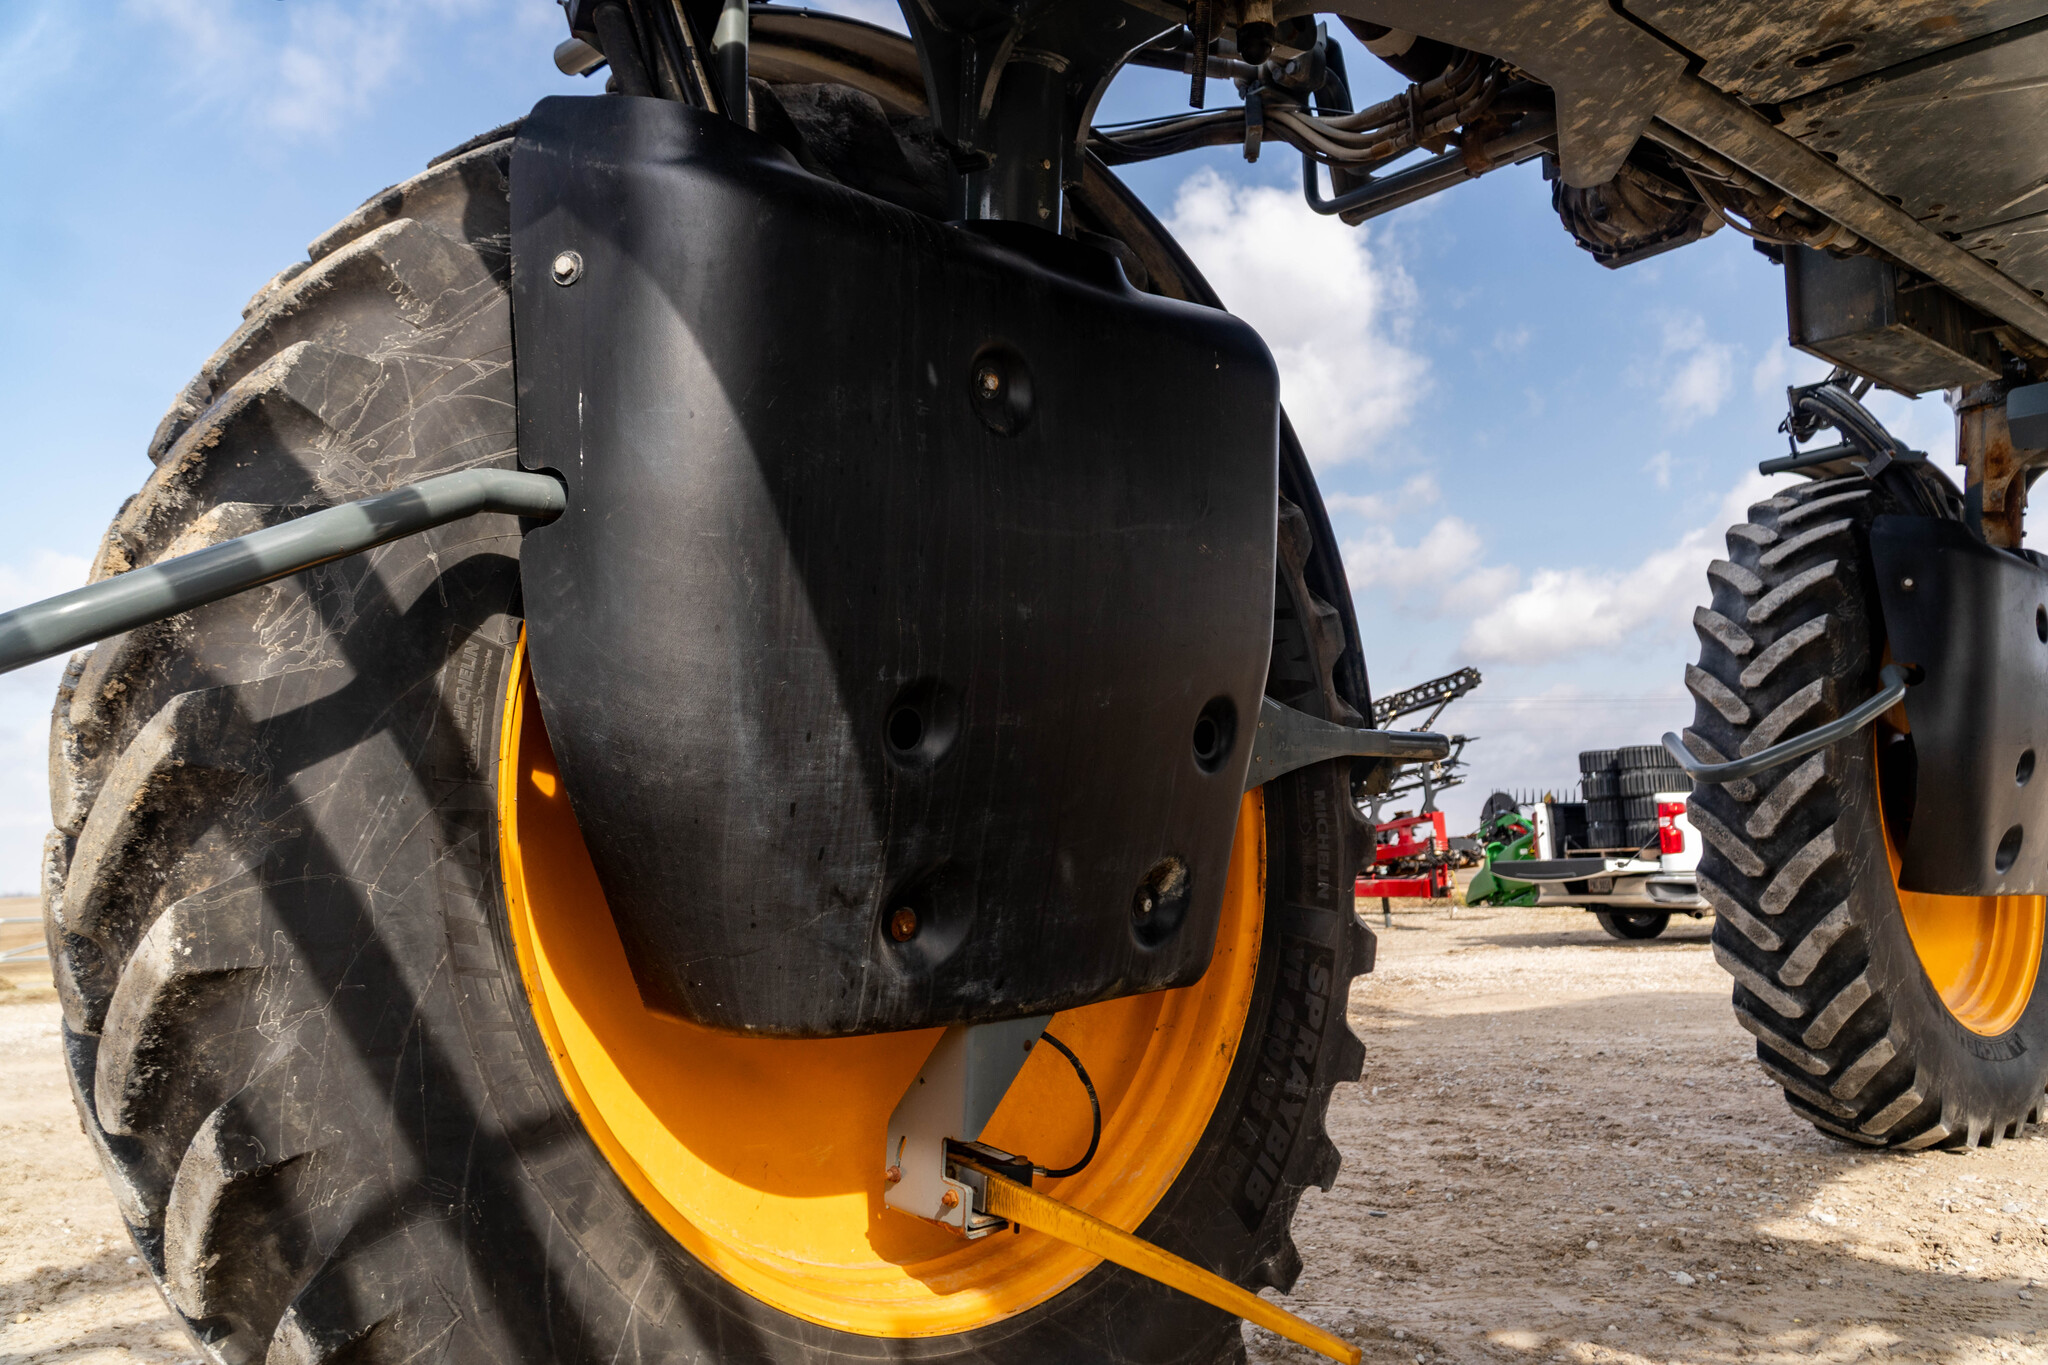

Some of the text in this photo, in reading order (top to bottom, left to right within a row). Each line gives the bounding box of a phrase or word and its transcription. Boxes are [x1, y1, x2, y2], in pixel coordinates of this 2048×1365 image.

[451, 639, 480, 729] MICHELIN
[1313, 789, 1330, 899] MICHELIN
[1244, 962, 1332, 1211] SPRAYBIB
